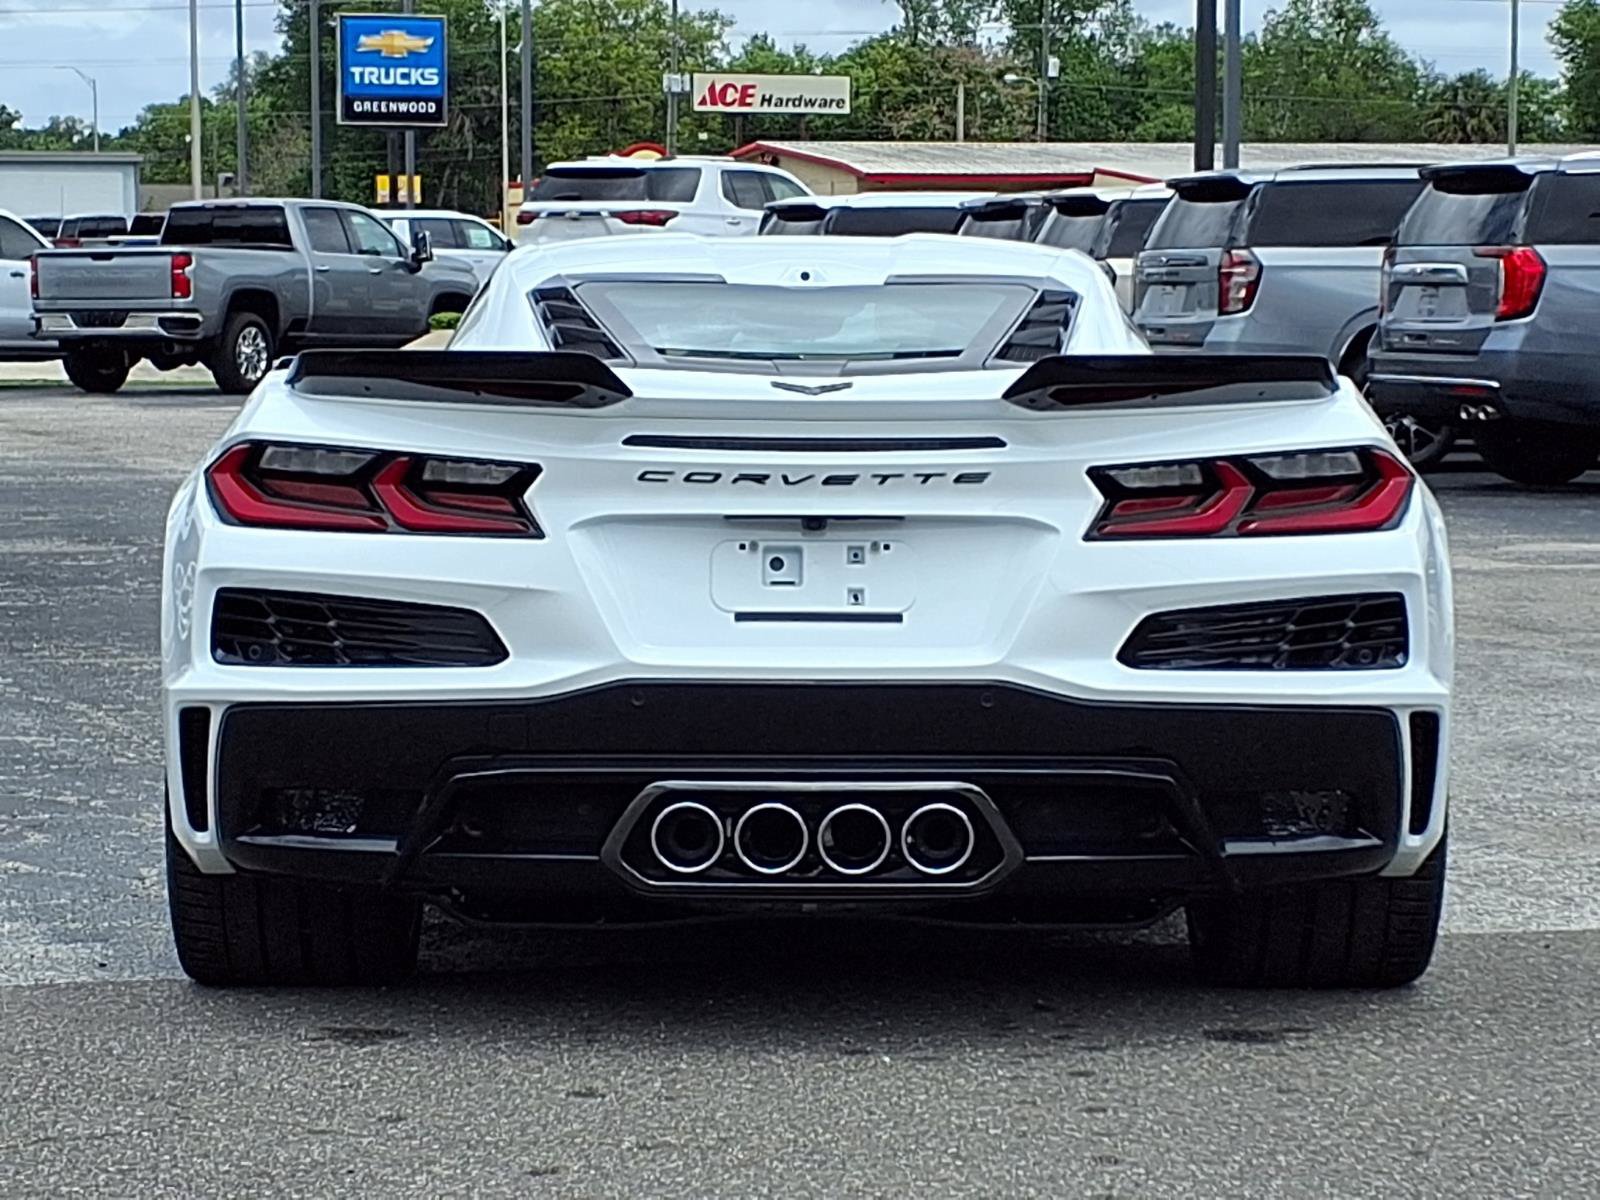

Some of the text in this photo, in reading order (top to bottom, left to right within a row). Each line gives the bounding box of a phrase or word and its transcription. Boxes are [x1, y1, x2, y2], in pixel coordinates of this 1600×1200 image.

[349, 66, 440, 86] TRUCKS
[697, 79, 846, 109] ACE Hardware
[353, 101, 437, 113] GREENWOOD
[637, 470, 992, 486] CORVETTE
